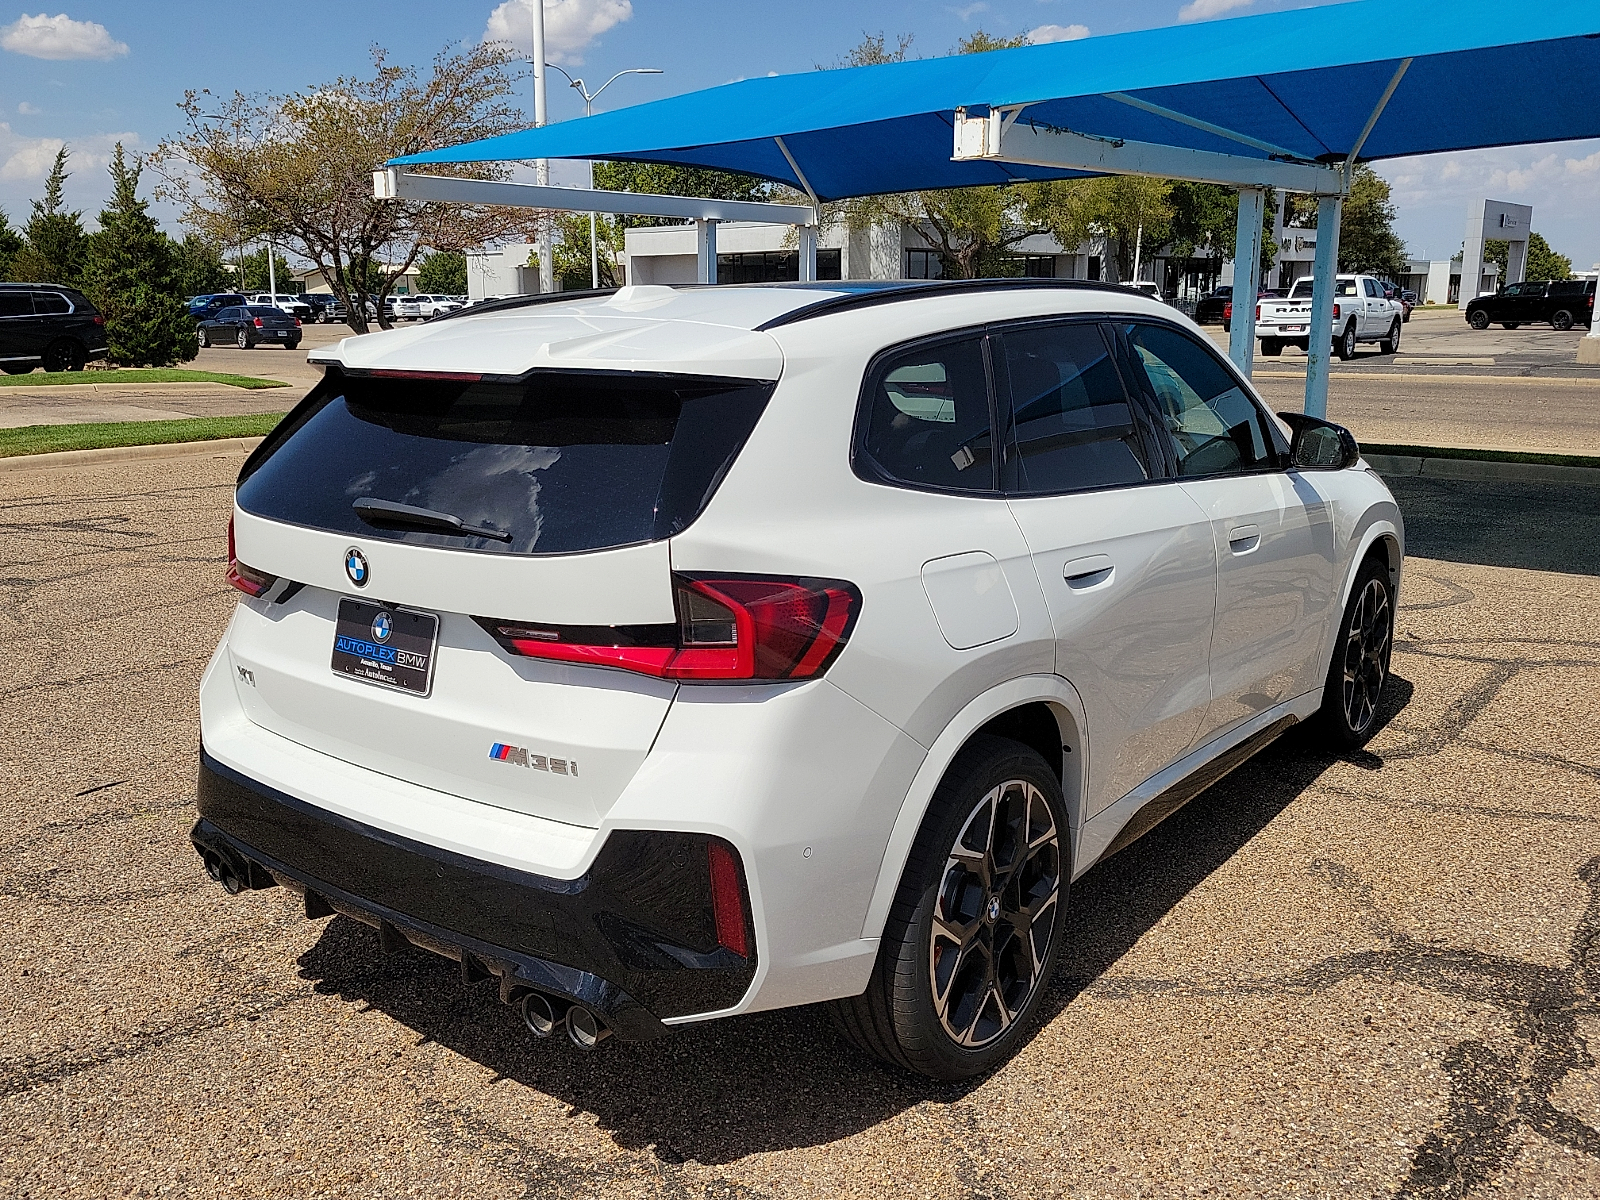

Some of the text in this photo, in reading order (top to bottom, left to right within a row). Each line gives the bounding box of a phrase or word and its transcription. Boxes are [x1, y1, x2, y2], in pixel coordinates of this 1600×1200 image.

[336, 638, 426, 668] AUTOPLEX BMW
[236, 664, 256, 688] X1
[504, 744, 579, 778] M35i
